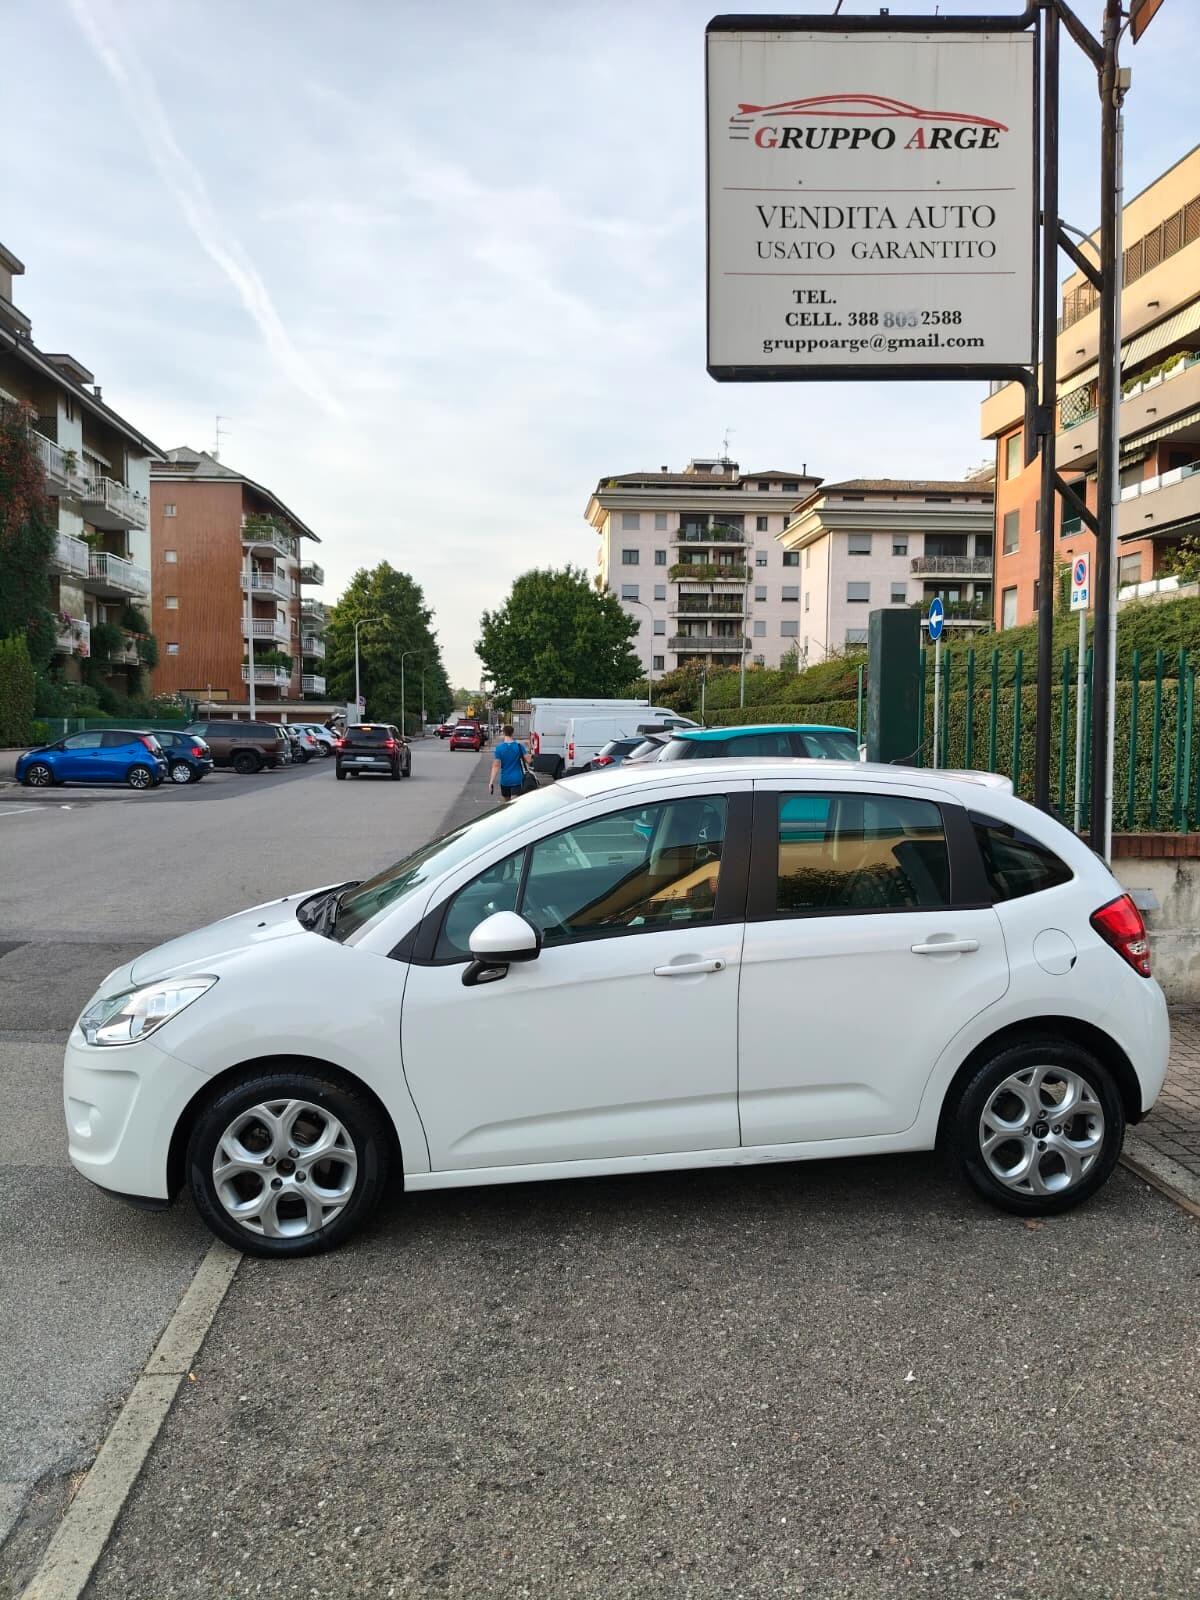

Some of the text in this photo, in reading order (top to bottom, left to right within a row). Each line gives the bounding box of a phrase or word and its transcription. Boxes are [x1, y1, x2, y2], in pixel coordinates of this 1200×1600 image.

[754, 126, 1000, 150] GRUPPO ARGE
[755, 204, 997, 230] VENDITA AUTO
[756, 240, 997, 260] USATO GARANTITO
[792, 289, 838, 305] TEL.
[785, 311, 843, 327] CELL.
[847, 311, 880, 327] 388
[920, 310, 963, 326] 2588
[762, 333, 985, 354] gruppoarge@gmail.com
